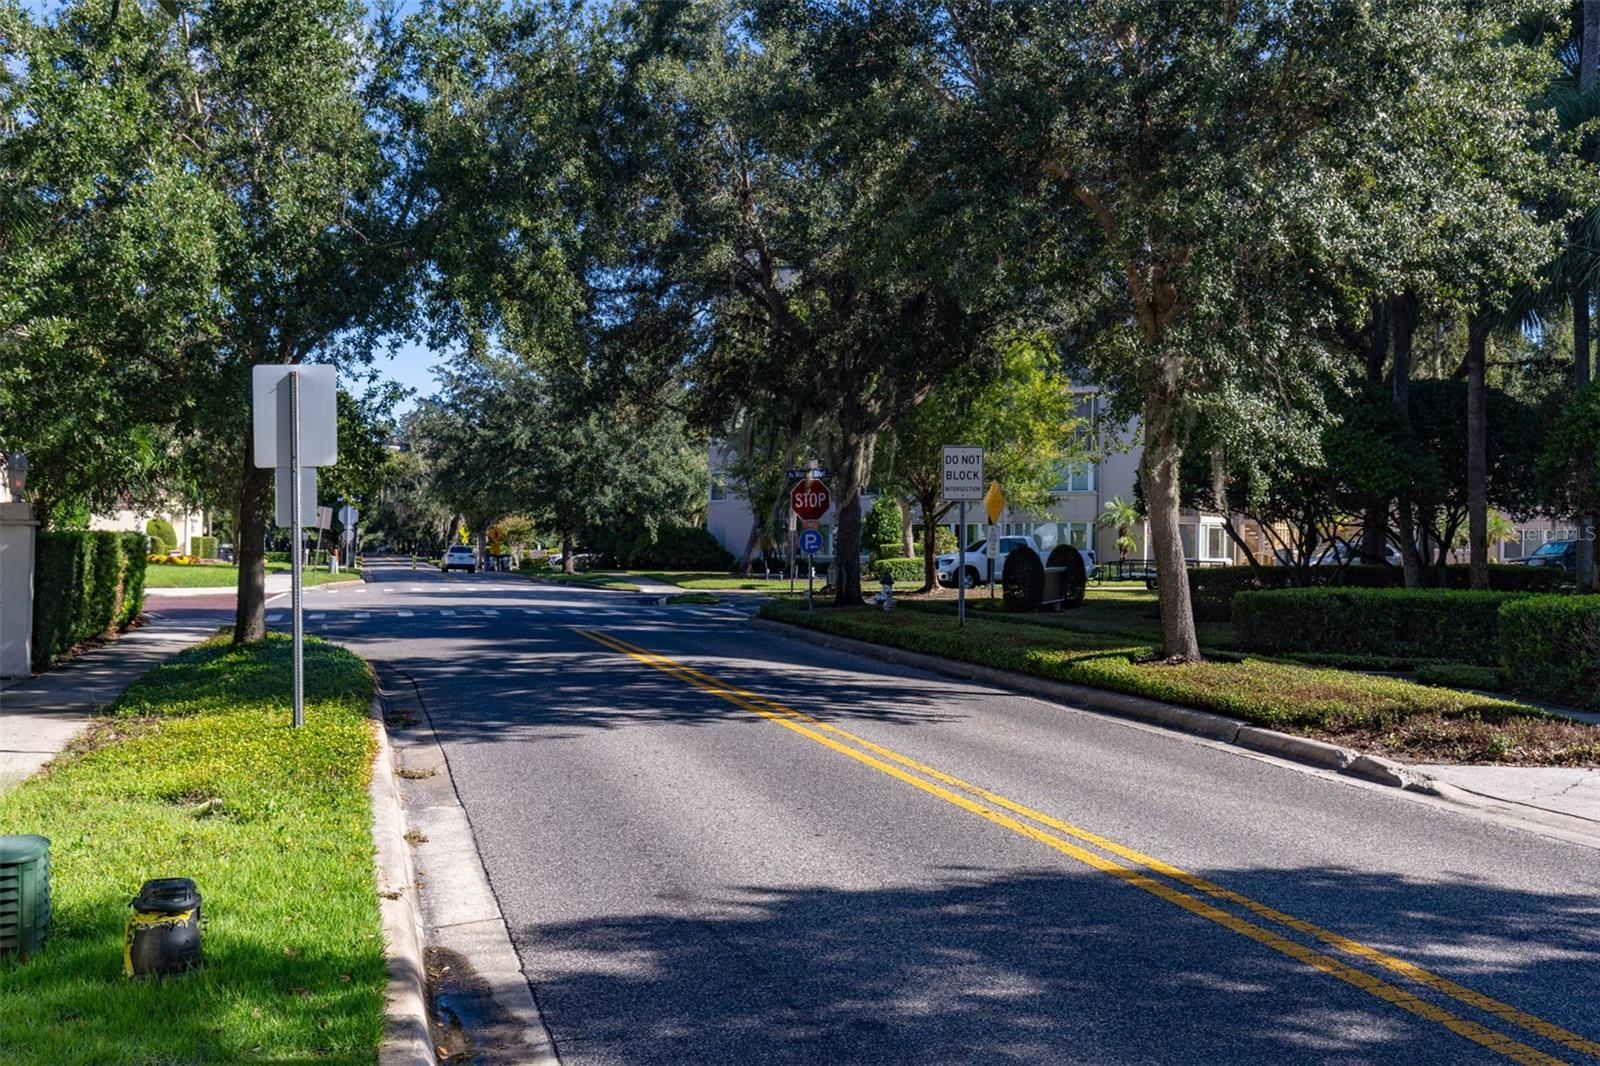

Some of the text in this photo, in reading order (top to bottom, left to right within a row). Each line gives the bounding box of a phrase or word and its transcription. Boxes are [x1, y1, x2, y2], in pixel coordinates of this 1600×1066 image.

[945, 455, 981, 465] DO NOT
[946, 470, 980, 481] BLOCK
[795, 492, 827, 508] STOP
[805, 533, 817, 550] P
